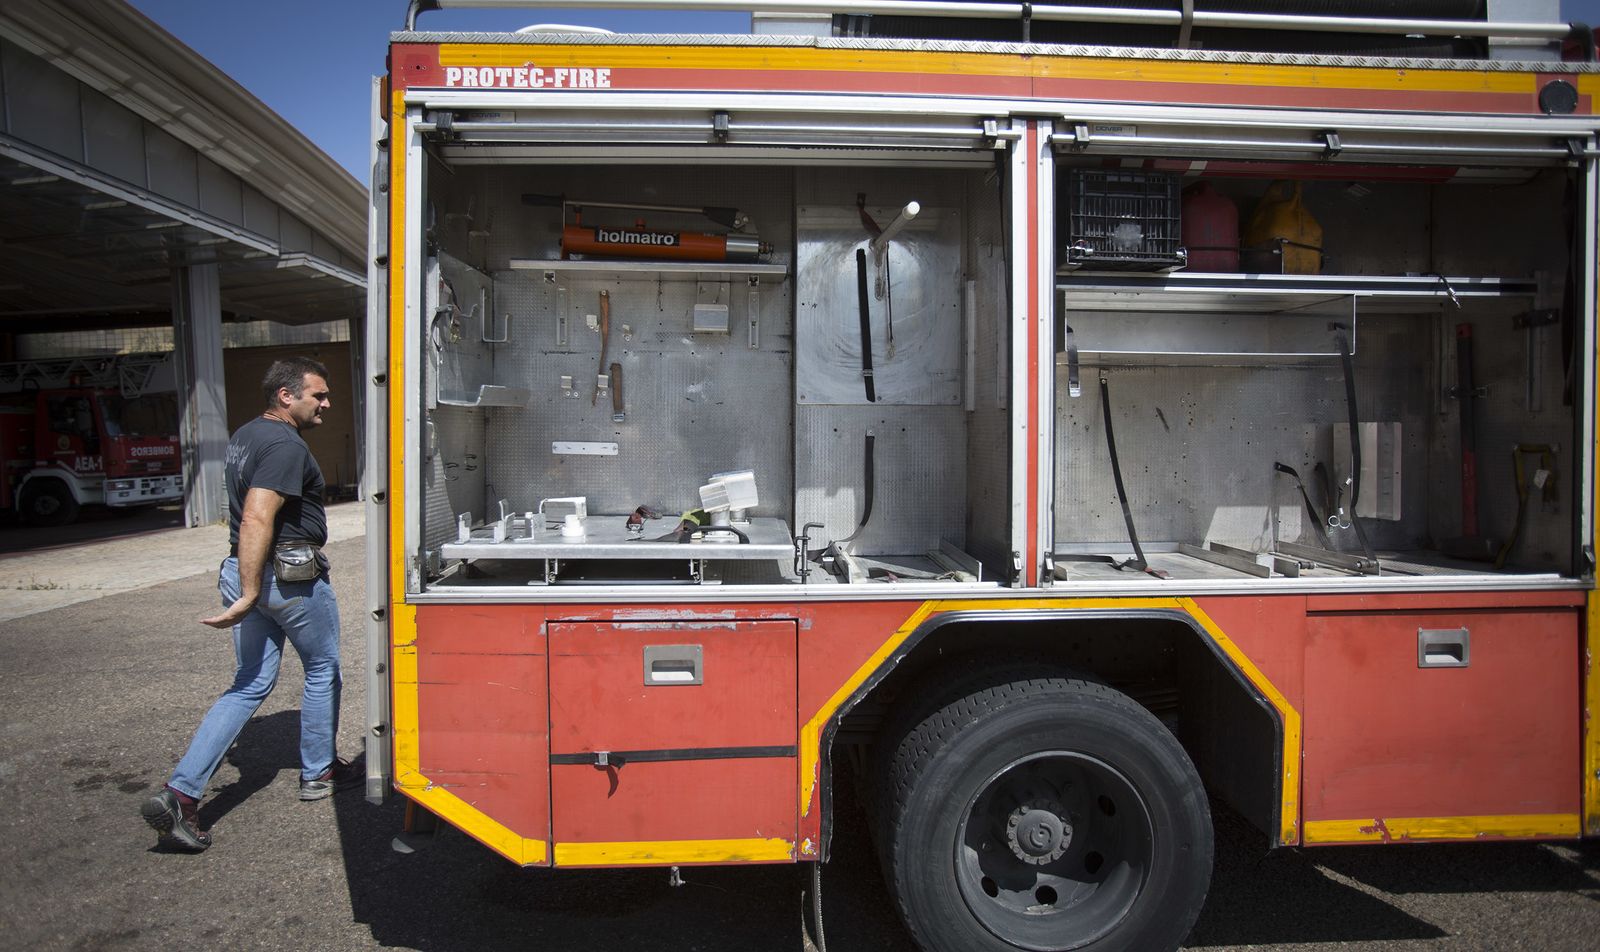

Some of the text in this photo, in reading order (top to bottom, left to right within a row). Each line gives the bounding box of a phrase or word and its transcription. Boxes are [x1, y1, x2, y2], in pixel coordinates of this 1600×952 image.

[446, 67, 611, 88] PROTEC-FIRE
[599, 229, 675, 245] holmatro
[74, 456, 103, 471] AEA-1
